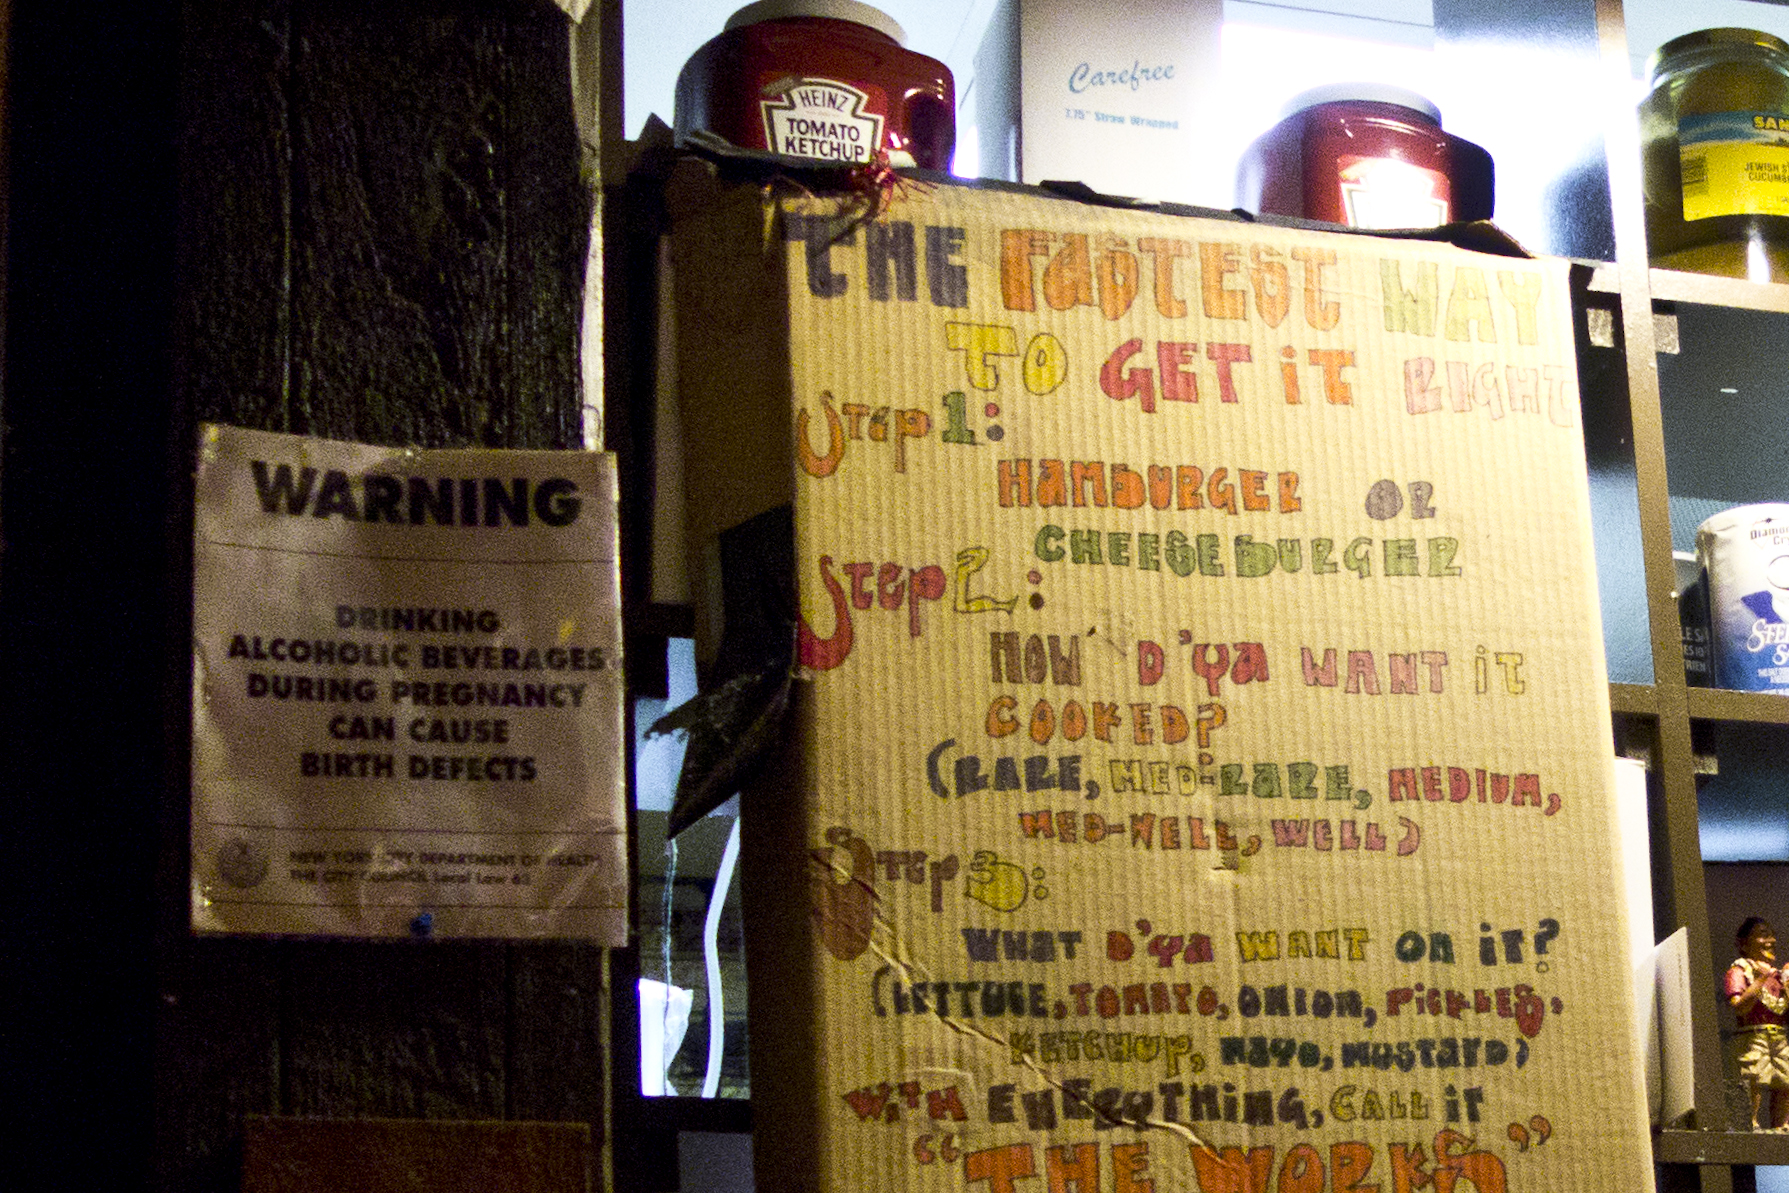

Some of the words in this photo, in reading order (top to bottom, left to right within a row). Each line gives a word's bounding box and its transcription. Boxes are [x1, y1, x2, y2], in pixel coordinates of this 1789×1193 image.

[1069, 60, 1176, 94] Carefree
[797, 86, 849, 113] HEINZ
[785, 117, 860, 142] TOMATO
[785, 136, 865, 162] KETCHUP
[1744, 162, 1780, 174] JEWISH
[782, 212, 971, 308] THE
[1377, 256, 1545, 347] WAY
[943, 319, 1068, 397] TO
[1097, 336, 1253, 413] GET
[1402, 354, 1580, 429] RIGHT
[250, 460, 584, 528] WARNING
[1364, 477, 1438, 521] OR
[335, 604, 501, 634] DRINKING
[228, 634, 409, 670] ALCOHOLIC
[421, 646, 607, 672] BEVERAGES
[989, 629, 1083, 687] HOW
[1300, 645, 1449, 696] WANT
[247, 672, 379, 702] DURING
[391, 682, 589, 709] PREGNANCY
[329, 715, 395, 741] CAN
[407, 717, 510, 745] CAUSE
[300, 752, 395, 779] BIRTH
[408, 755, 538, 783] DEFECTS
[925, 739, 1101, 800] (RARE,
[1270, 815, 1422, 857] WELL)
[961, 925, 1083, 963] WHAT
[1235, 927, 1371, 963] WANT
[1394, 929, 1455, 965] ON
[1067, 982, 1230, 1021] TOMATO,
[1329, 1084, 1430, 1123] CALL
